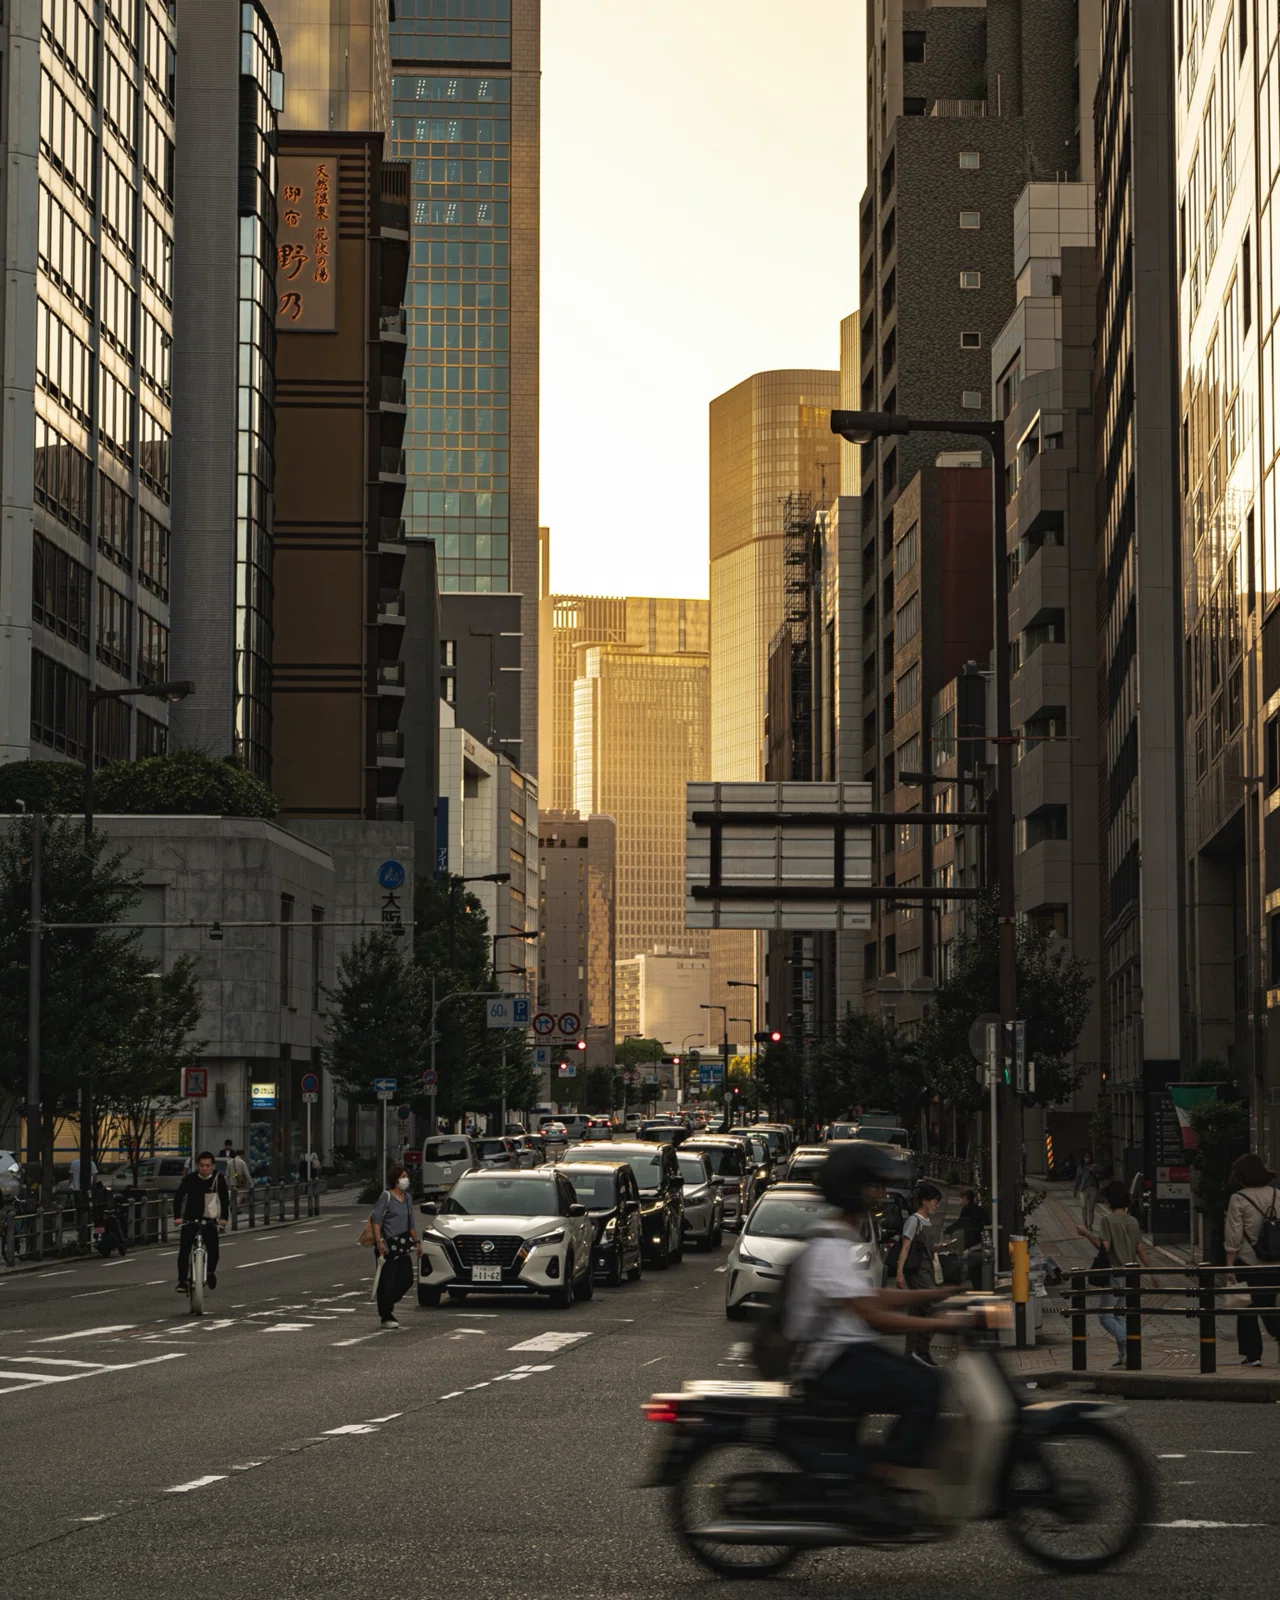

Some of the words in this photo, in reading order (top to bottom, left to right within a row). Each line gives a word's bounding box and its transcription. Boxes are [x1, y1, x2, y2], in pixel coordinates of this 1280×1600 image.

[283, 185, 302, 227] 御宿
[315, 164, 329, 220] 天然温泉
[517, 1002, 525, 1013] P
